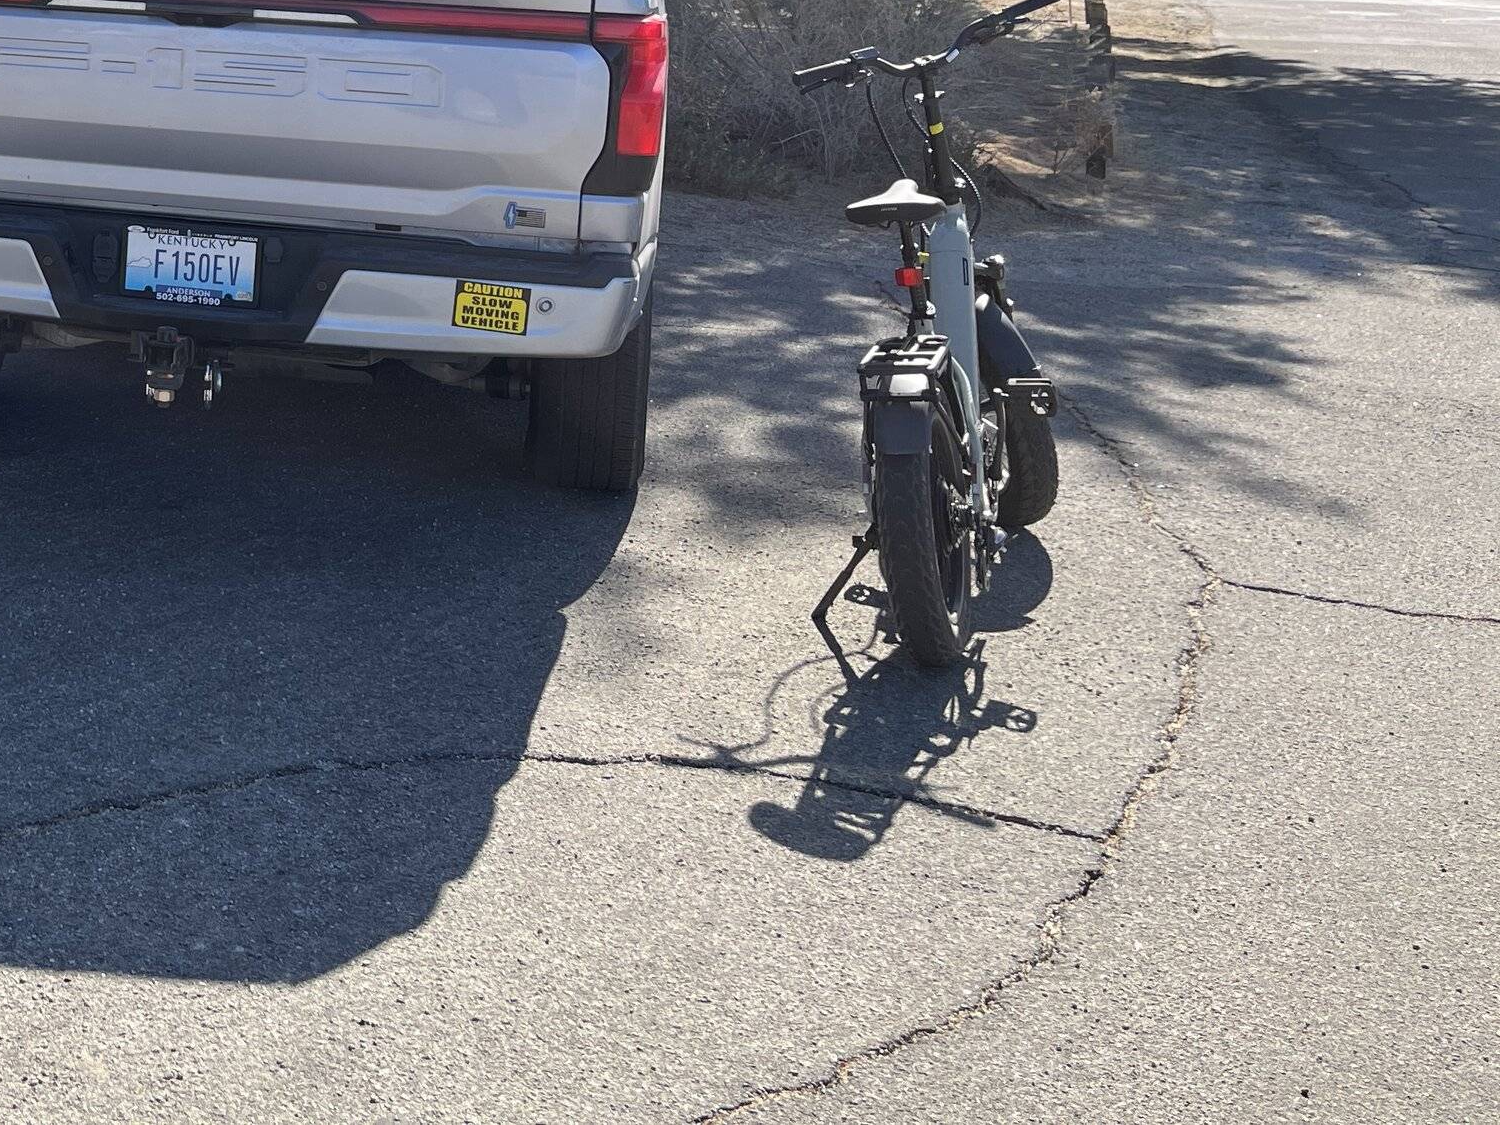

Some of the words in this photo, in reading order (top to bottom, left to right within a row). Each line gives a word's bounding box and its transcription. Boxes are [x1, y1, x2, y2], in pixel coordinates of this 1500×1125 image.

[157, 235, 227, 250] KENTUCKY
[153, 248, 241, 286] F150EV
[166, 286, 211, 298] ANDERSON
[463, 282, 523, 299] CAUTION
[155, 292, 221, 306] 502-695-1990
[471, 296, 513, 309] SLOW
[462, 305, 520, 321] MOVING
[461, 315, 519, 331] VEHICLE
